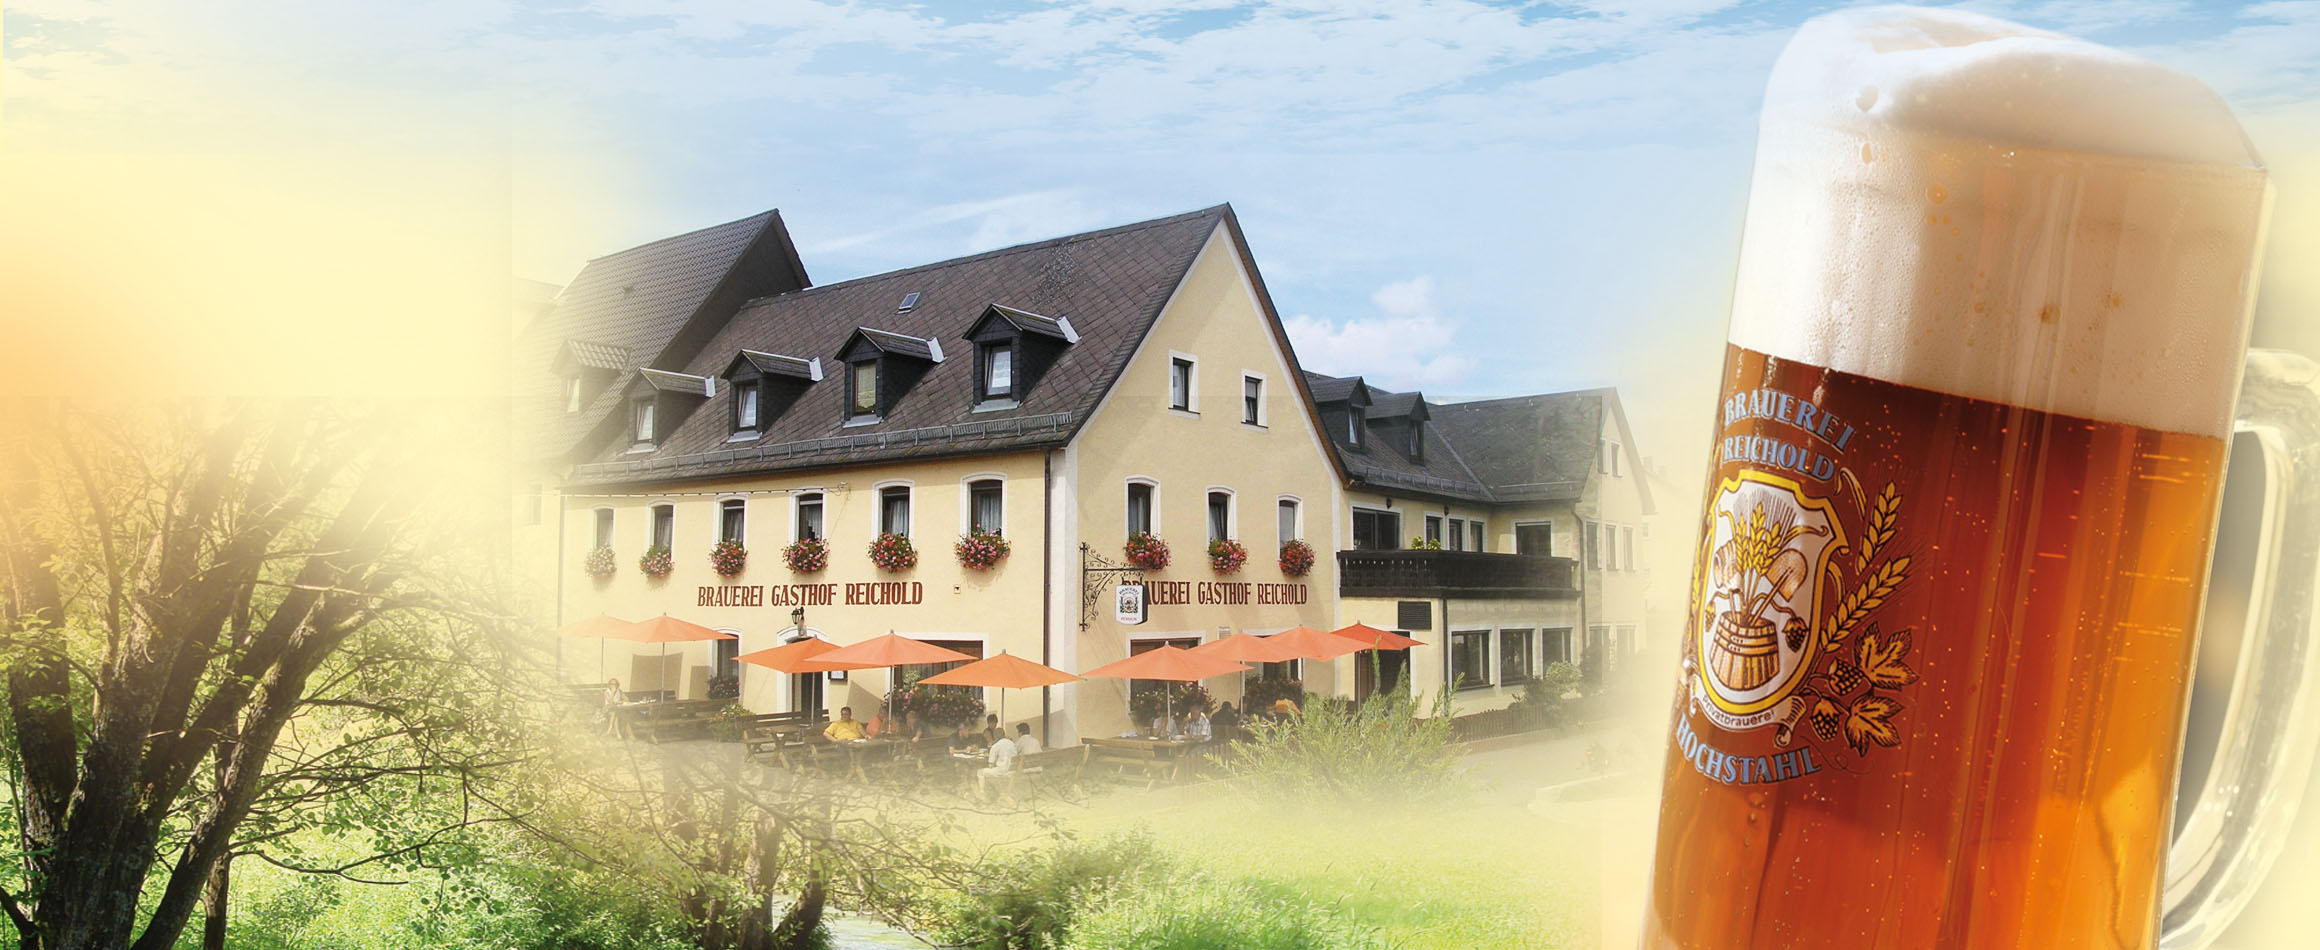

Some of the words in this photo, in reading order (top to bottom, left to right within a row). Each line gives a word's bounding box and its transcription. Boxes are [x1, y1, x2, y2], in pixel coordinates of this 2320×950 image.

[1723, 388, 1855, 454] BRAUEREI
[1723, 434, 1835, 482] REICHOLD
[697, 585, 764, 607] BRAUEREI
[771, 583, 838, 606] GASTHOF
[845, 581, 923, 606] REICHOLD
[1198, 581, 1251, 606] GASTHOF
[1257, 583, 1308, 606] REICHOLD
[1676, 711, 1822, 786] HOCHSTAHL
